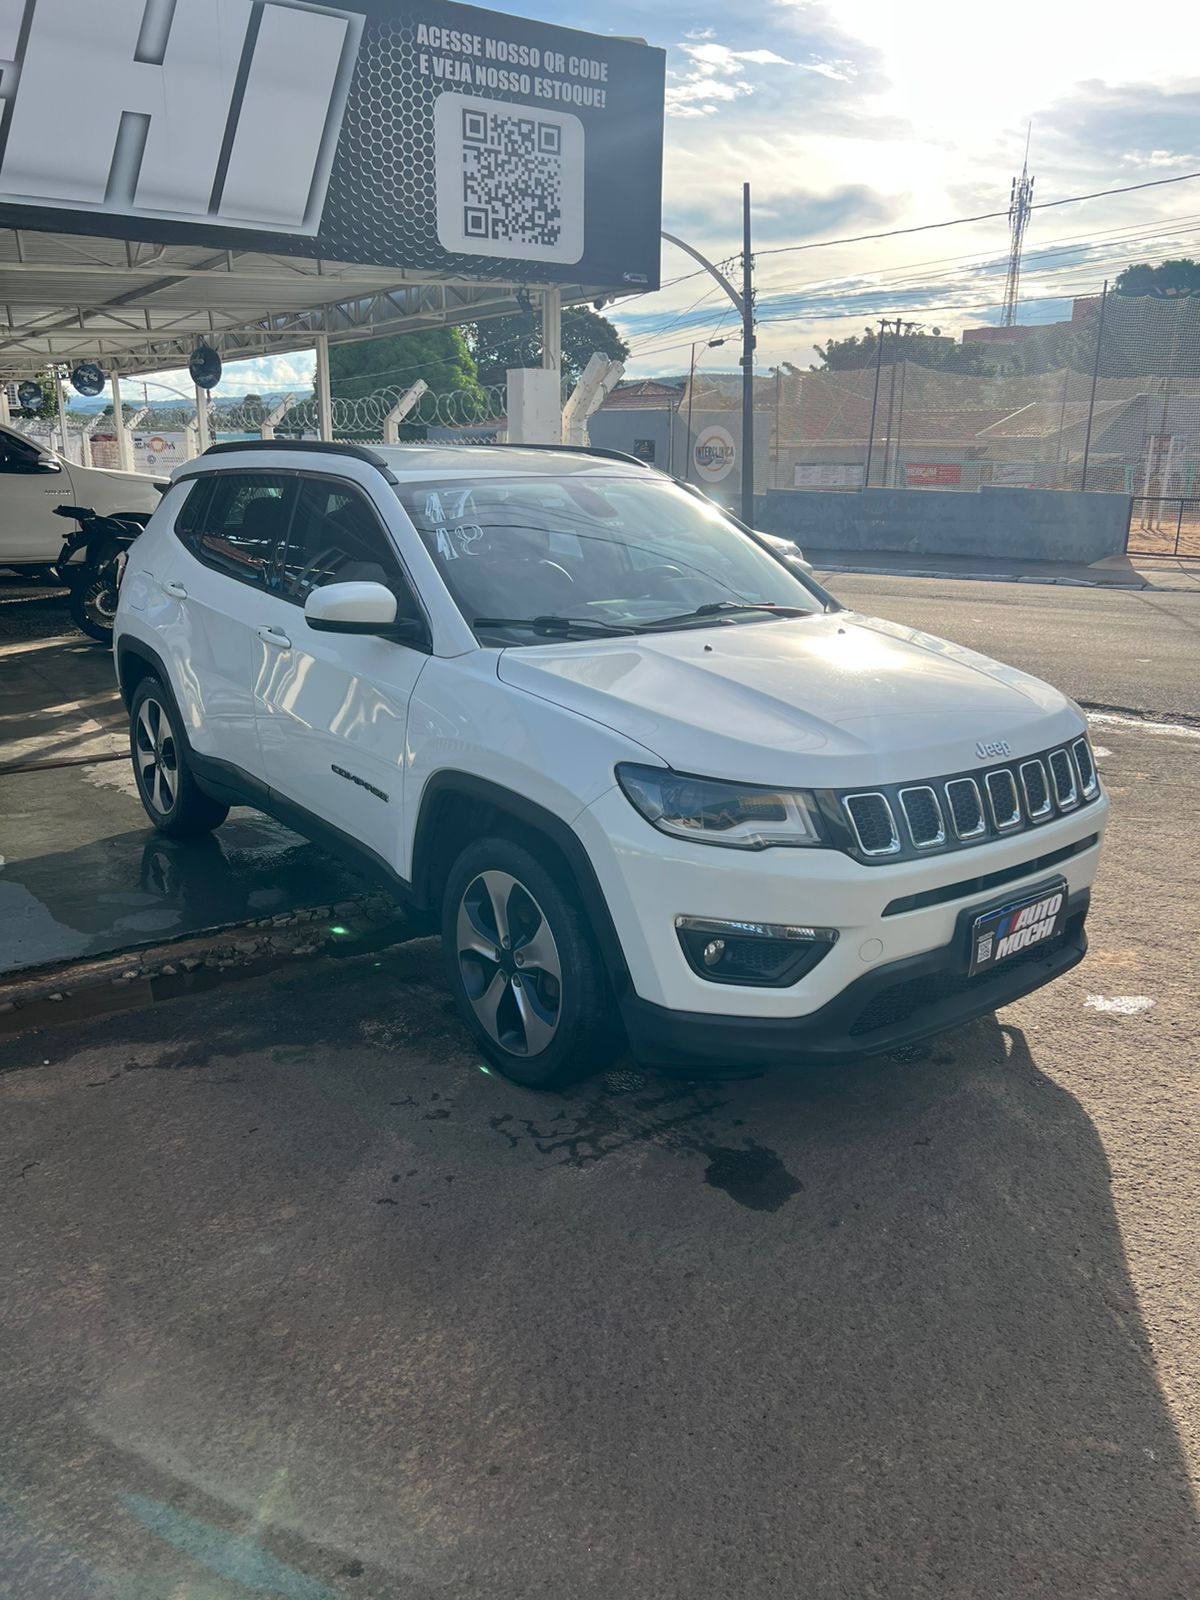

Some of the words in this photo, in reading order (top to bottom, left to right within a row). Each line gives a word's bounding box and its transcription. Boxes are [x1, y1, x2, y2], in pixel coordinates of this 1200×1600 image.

[417, 23, 481, 58] ACESSE
[485, 39, 540, 69] NOSSO
[543, 51, 566, 74] QR
[568, 56, 609, 82] CODE
[420, 54, 431, 75] E
[432, 57, 472, 83] VEJA
[475, 66, 531, 95] NOSSO
[534, 78, 607, 108] ESTOQUE!
[976, 740, 1012, 759] Jeep
[1013, 893, 1063, 932] AUTO
[995, 915, 1057, 961] MOCHI
